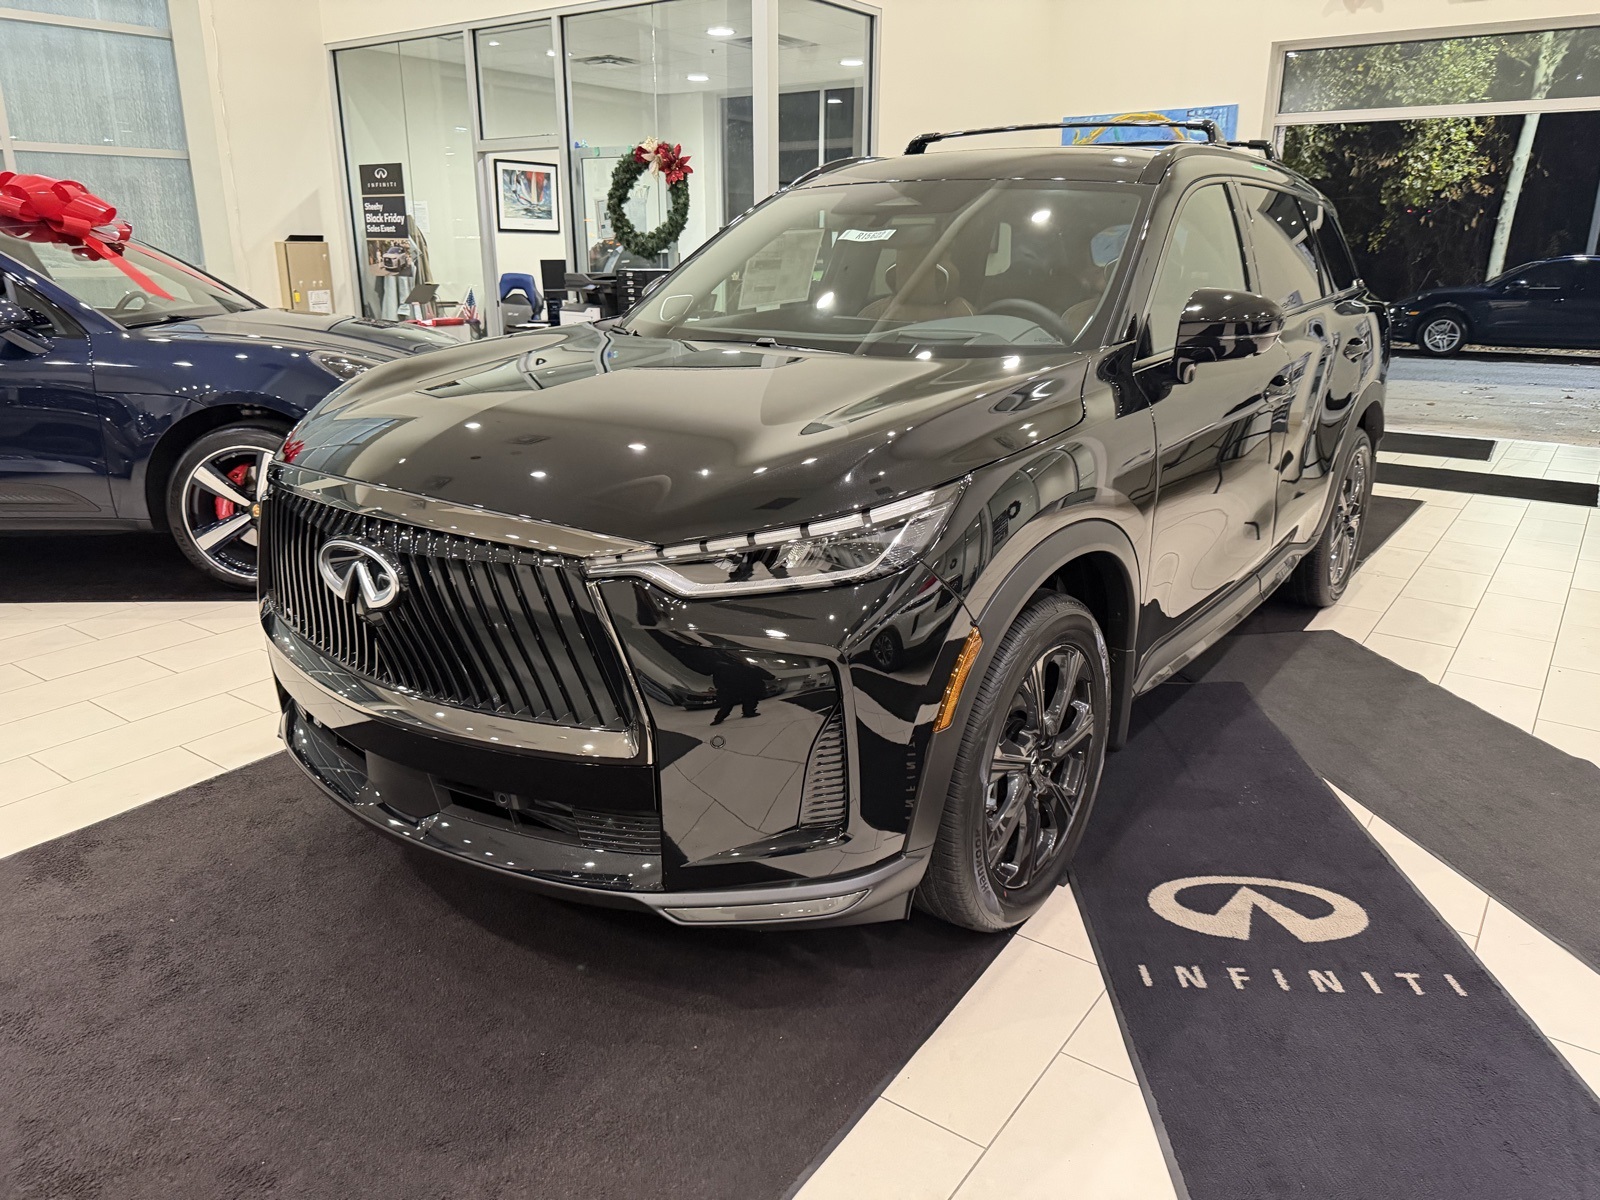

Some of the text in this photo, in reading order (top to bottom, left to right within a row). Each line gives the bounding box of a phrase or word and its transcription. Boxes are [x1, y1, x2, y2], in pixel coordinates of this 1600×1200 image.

[365, 213, 405, 225] Black Friday
[366, 224, 396, 232] Sales Event
[1137, 963, 1469, 997] INFINITI
